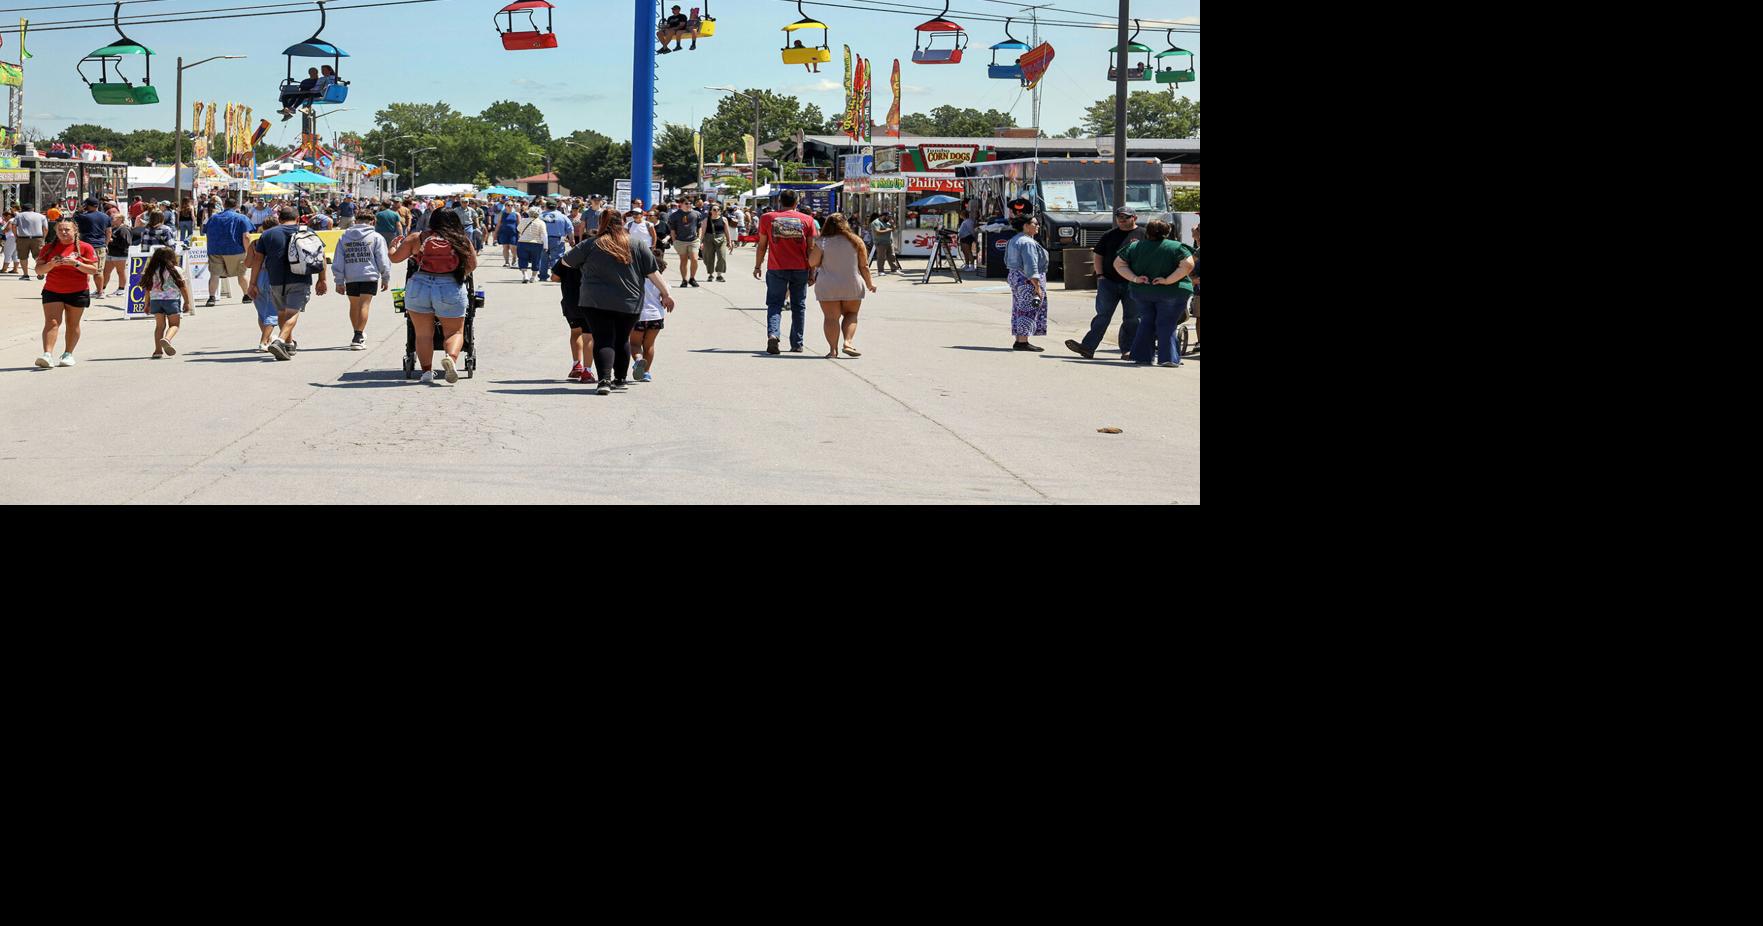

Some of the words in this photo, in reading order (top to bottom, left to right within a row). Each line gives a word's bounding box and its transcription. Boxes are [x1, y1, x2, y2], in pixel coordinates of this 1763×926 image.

[928, 152, 949, 162] CORN
[950, 152, 971, 161] DOGS
[908, 177, 943, 190] Philly
